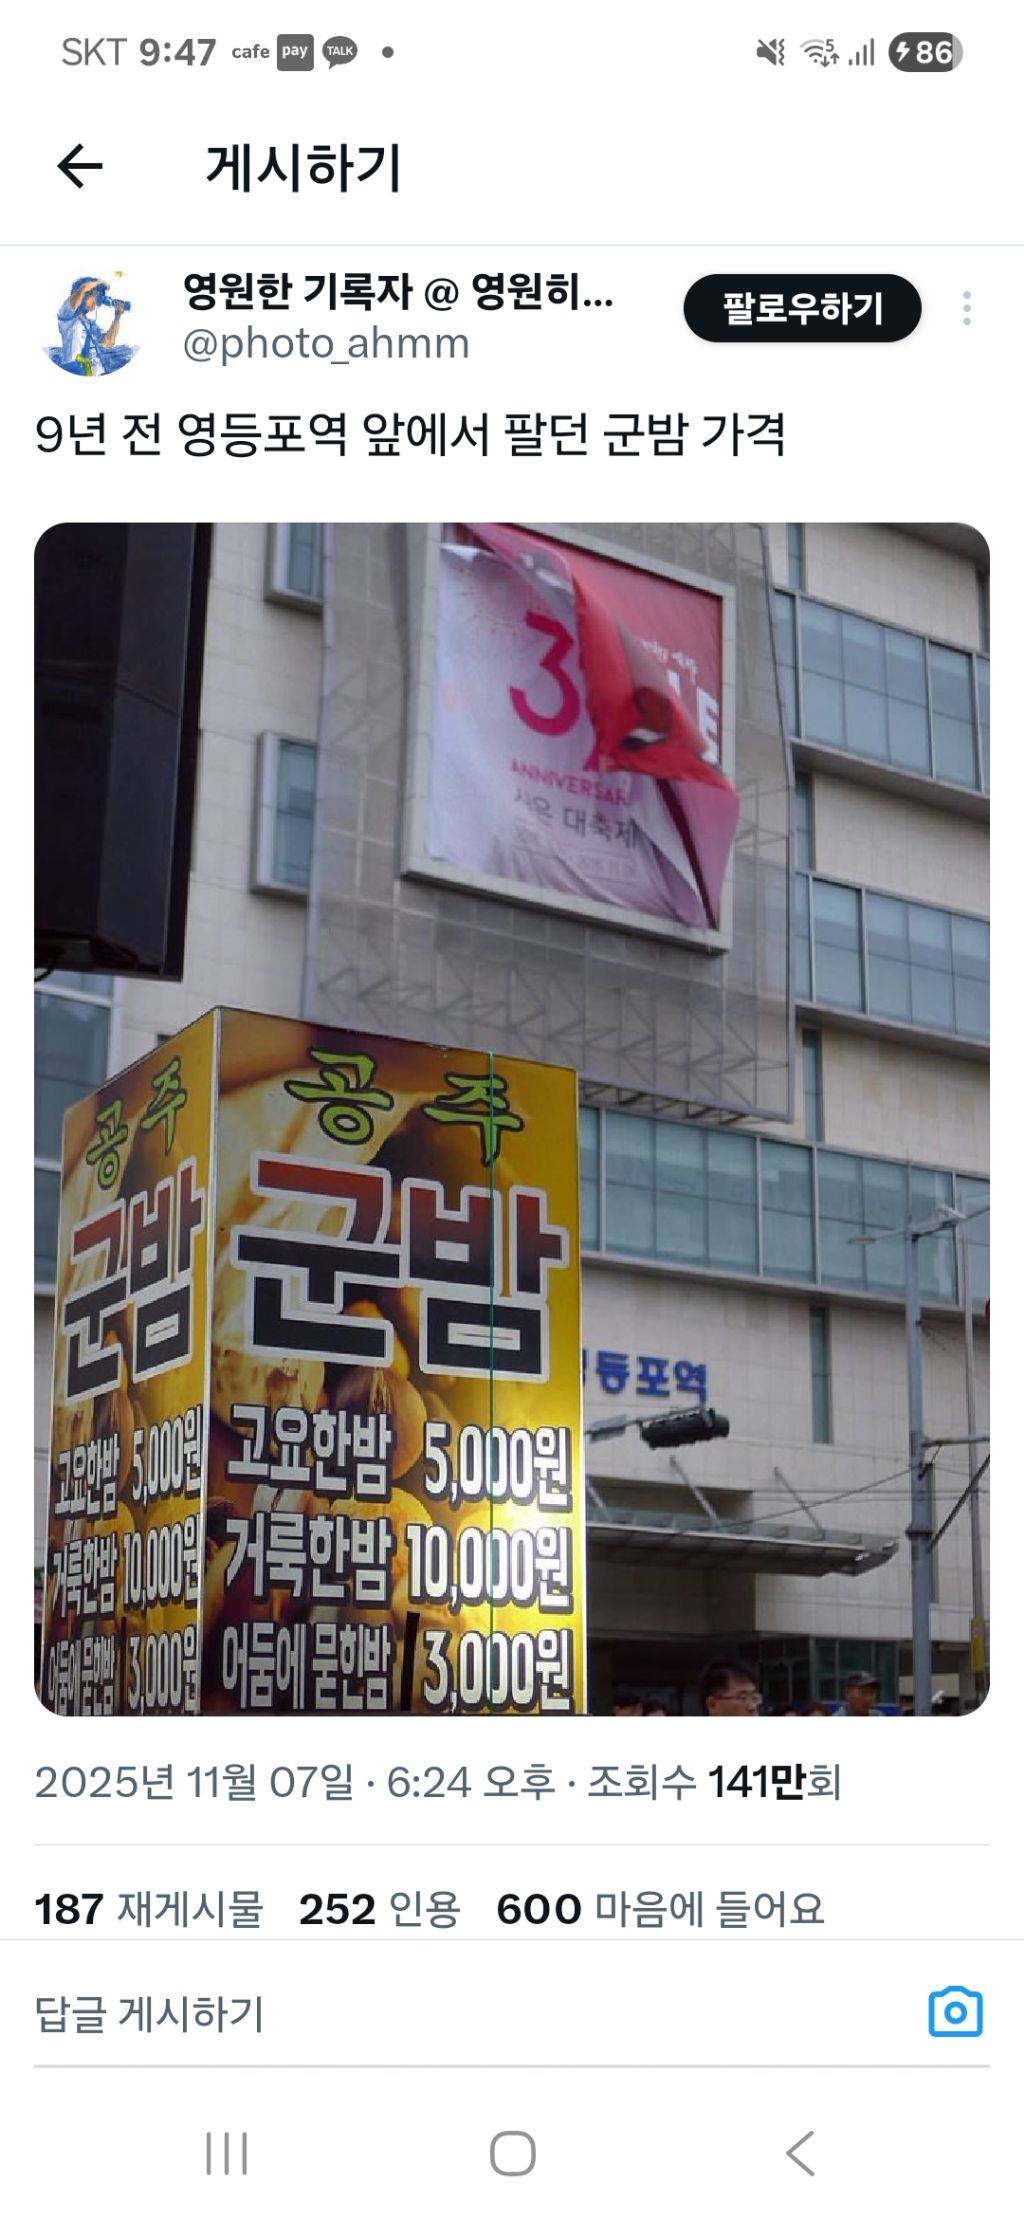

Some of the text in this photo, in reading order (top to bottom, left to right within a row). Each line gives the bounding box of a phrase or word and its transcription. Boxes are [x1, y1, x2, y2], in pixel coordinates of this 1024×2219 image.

[62, 38, 216, 66] SKT 9:47
[232, 44, 270, 59] cafe
[282, 44, 308, 60] pay
[327, 45, 354, 56] TALK
[916, 40, 953, 64] 86
[206, 143, 399, 193] 게시하기
[184, 272, 293, 312] 영원한
[304, 272, 413, 312] 기록자
[424, 277, 460, 312] @
[723, 291, 883, 326] 팔로우하기
[184, 325, 469, 366] @photo_ahmm
[36, 412, 784, 458] 9년 전 영등포역 앞에서 팔던 군밤 가격
[86, 1057, 187, 1190] 공주
[284, 1047, 524, 1163] 공주
[62, 1156, 205, 1403] 군밤
[232, 1152, 568, 1381] 군밤
[583, 1349, 708, 1403] 등포역
[55, 1406, 201, 1515] 고요한밤 5,000원
[226, 1404, 569, 1507] 고요한밤 5,000원
[52, 1513, 200, 1618] 거룩한밤 10,000원
[225, 1511, 570, 1609] 거룩한밤 10,000원
[48, 1640, 81, 1717] 어둠에
[128, 1625, 198, 1716] 3,000원
[221, 1622, 571, 1713] 어둠에 묻힌밤 3,000원
[35, 1763, 840, 1802] 2025년 11월 07일 6:24 오후 조회수 141만회
[35, 1890, 825, 1929] 187 재게시물 252 인용 600 마음에 들어요
[36, 1995, 264, 2034] 답글 게시하기
